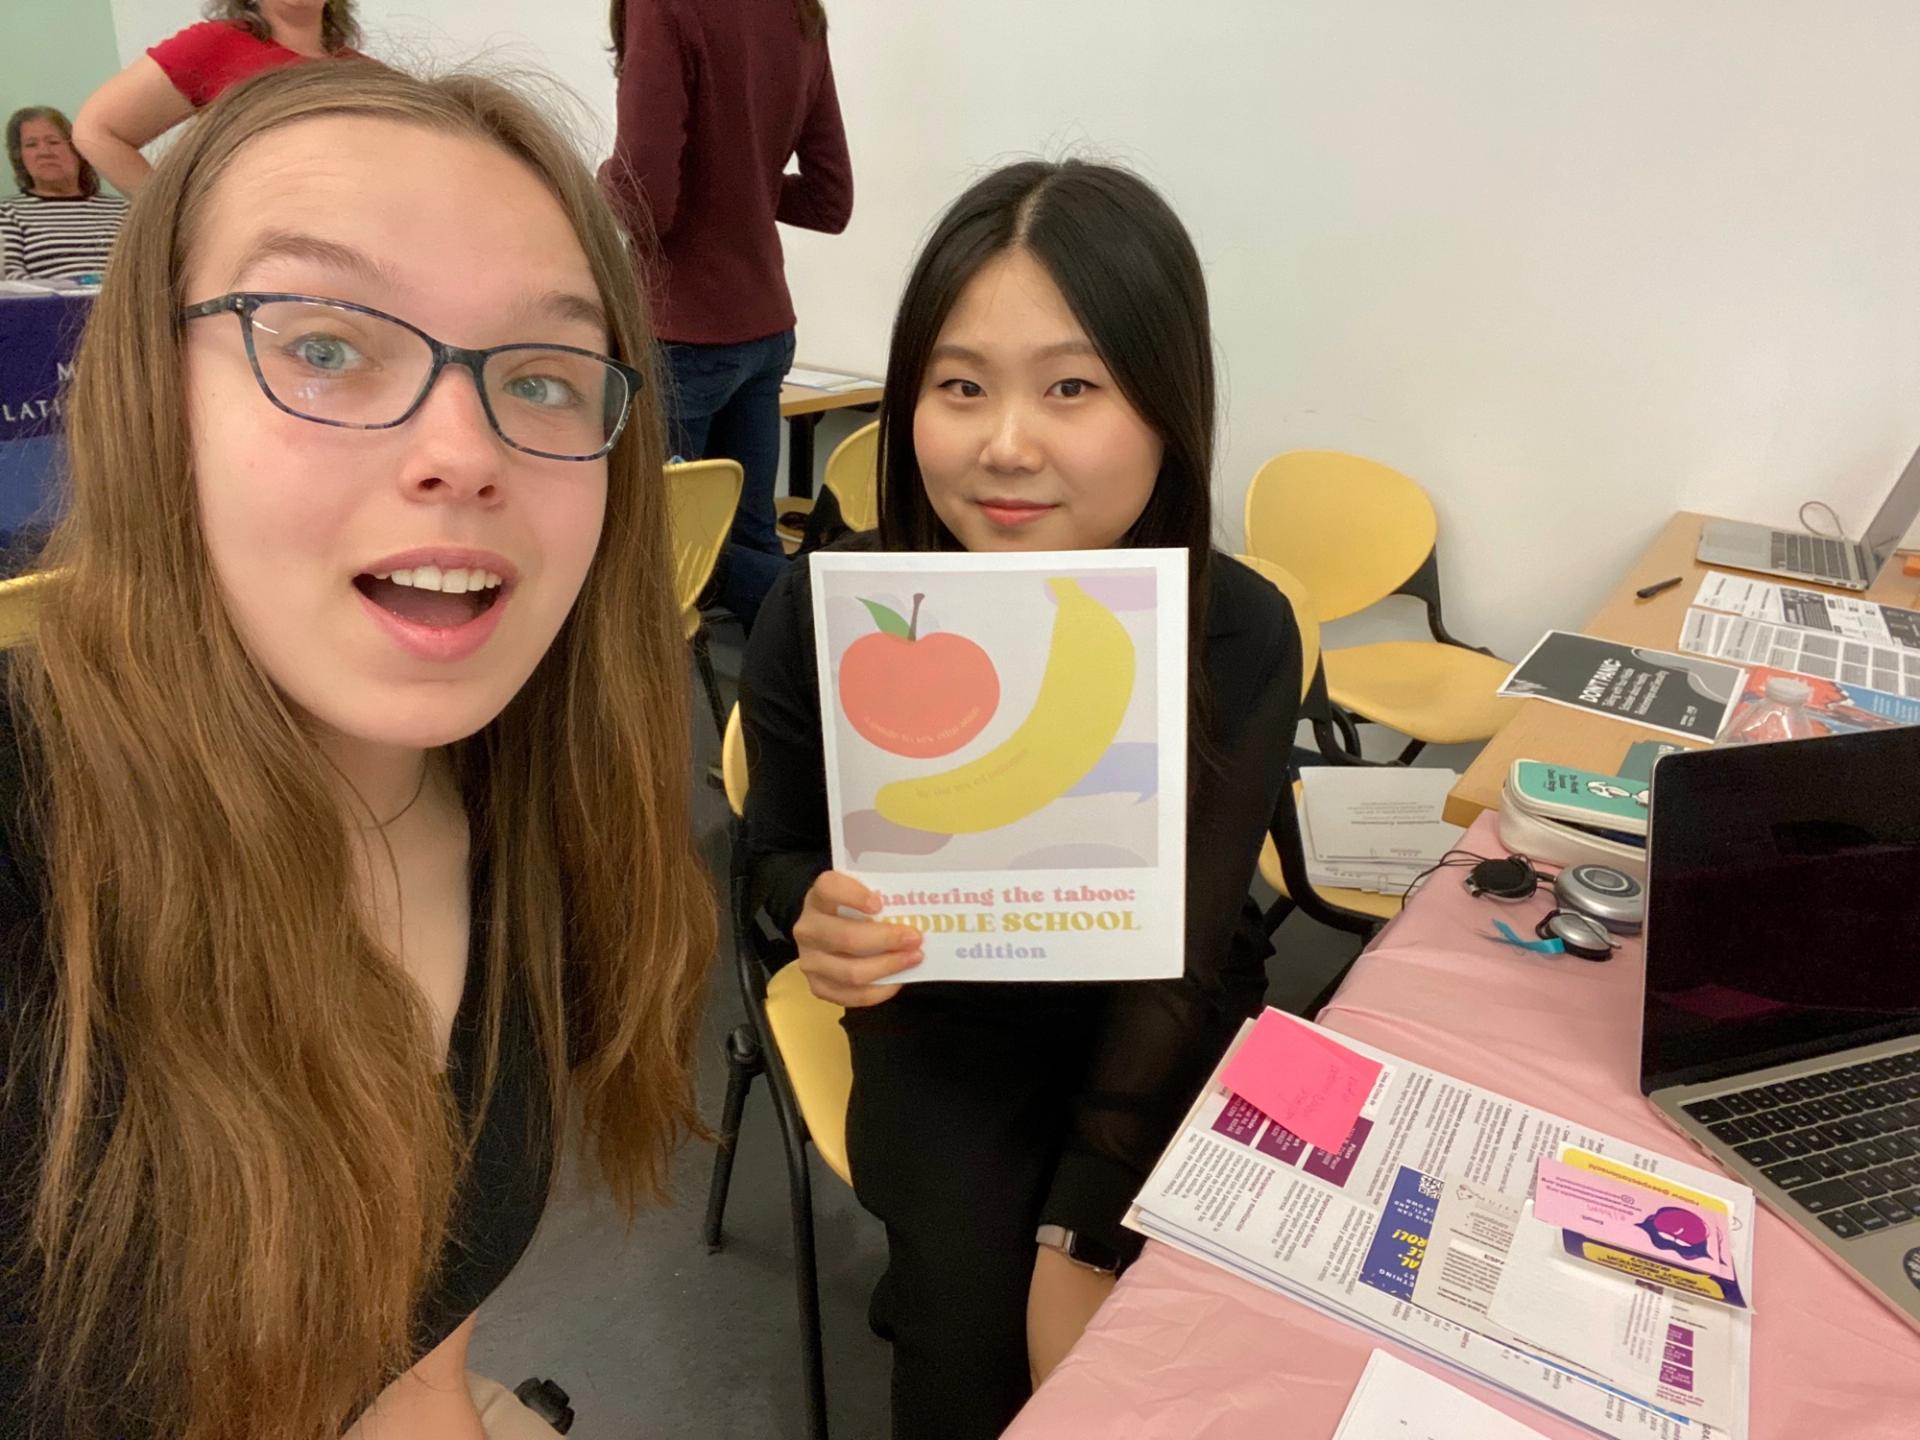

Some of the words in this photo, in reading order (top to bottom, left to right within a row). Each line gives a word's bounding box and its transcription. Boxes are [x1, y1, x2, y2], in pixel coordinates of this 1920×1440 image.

[879, 887, 995, 906] hattering
[1002, 886, 1045, 903] the
[1054, 885, 1136, 902] taboo:
[880, 911, 996, 933] DDLE
[1001, 910, 1141, 932] SCHOOL
[954, 943, 1048, 959] edition
